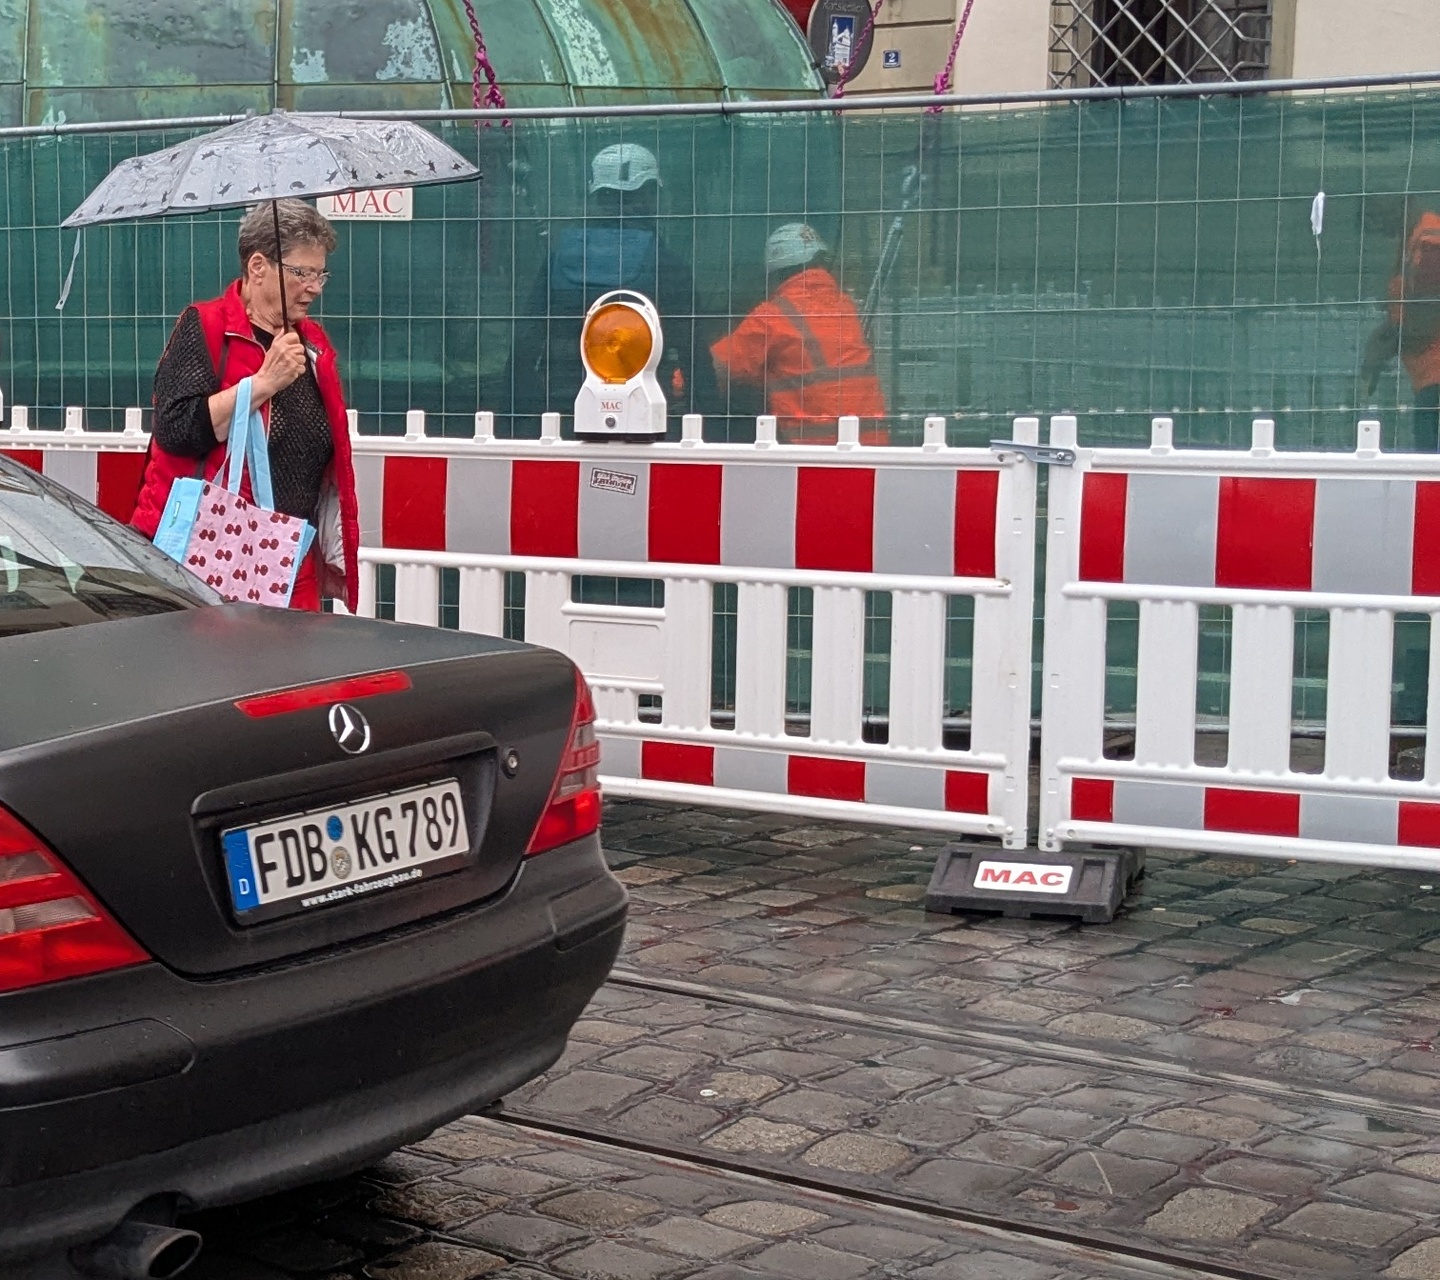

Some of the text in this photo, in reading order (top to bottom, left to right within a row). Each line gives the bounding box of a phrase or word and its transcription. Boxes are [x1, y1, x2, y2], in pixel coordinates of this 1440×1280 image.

[888, 52, 896, 63] 2
[331, 188, 404, 214] MAC
[601, 401, 622, 410] MAC
[239, 878, 251, 896] D
[254, 824, 328, 895] FDB
[980, 868, 1065, 887] MAC
